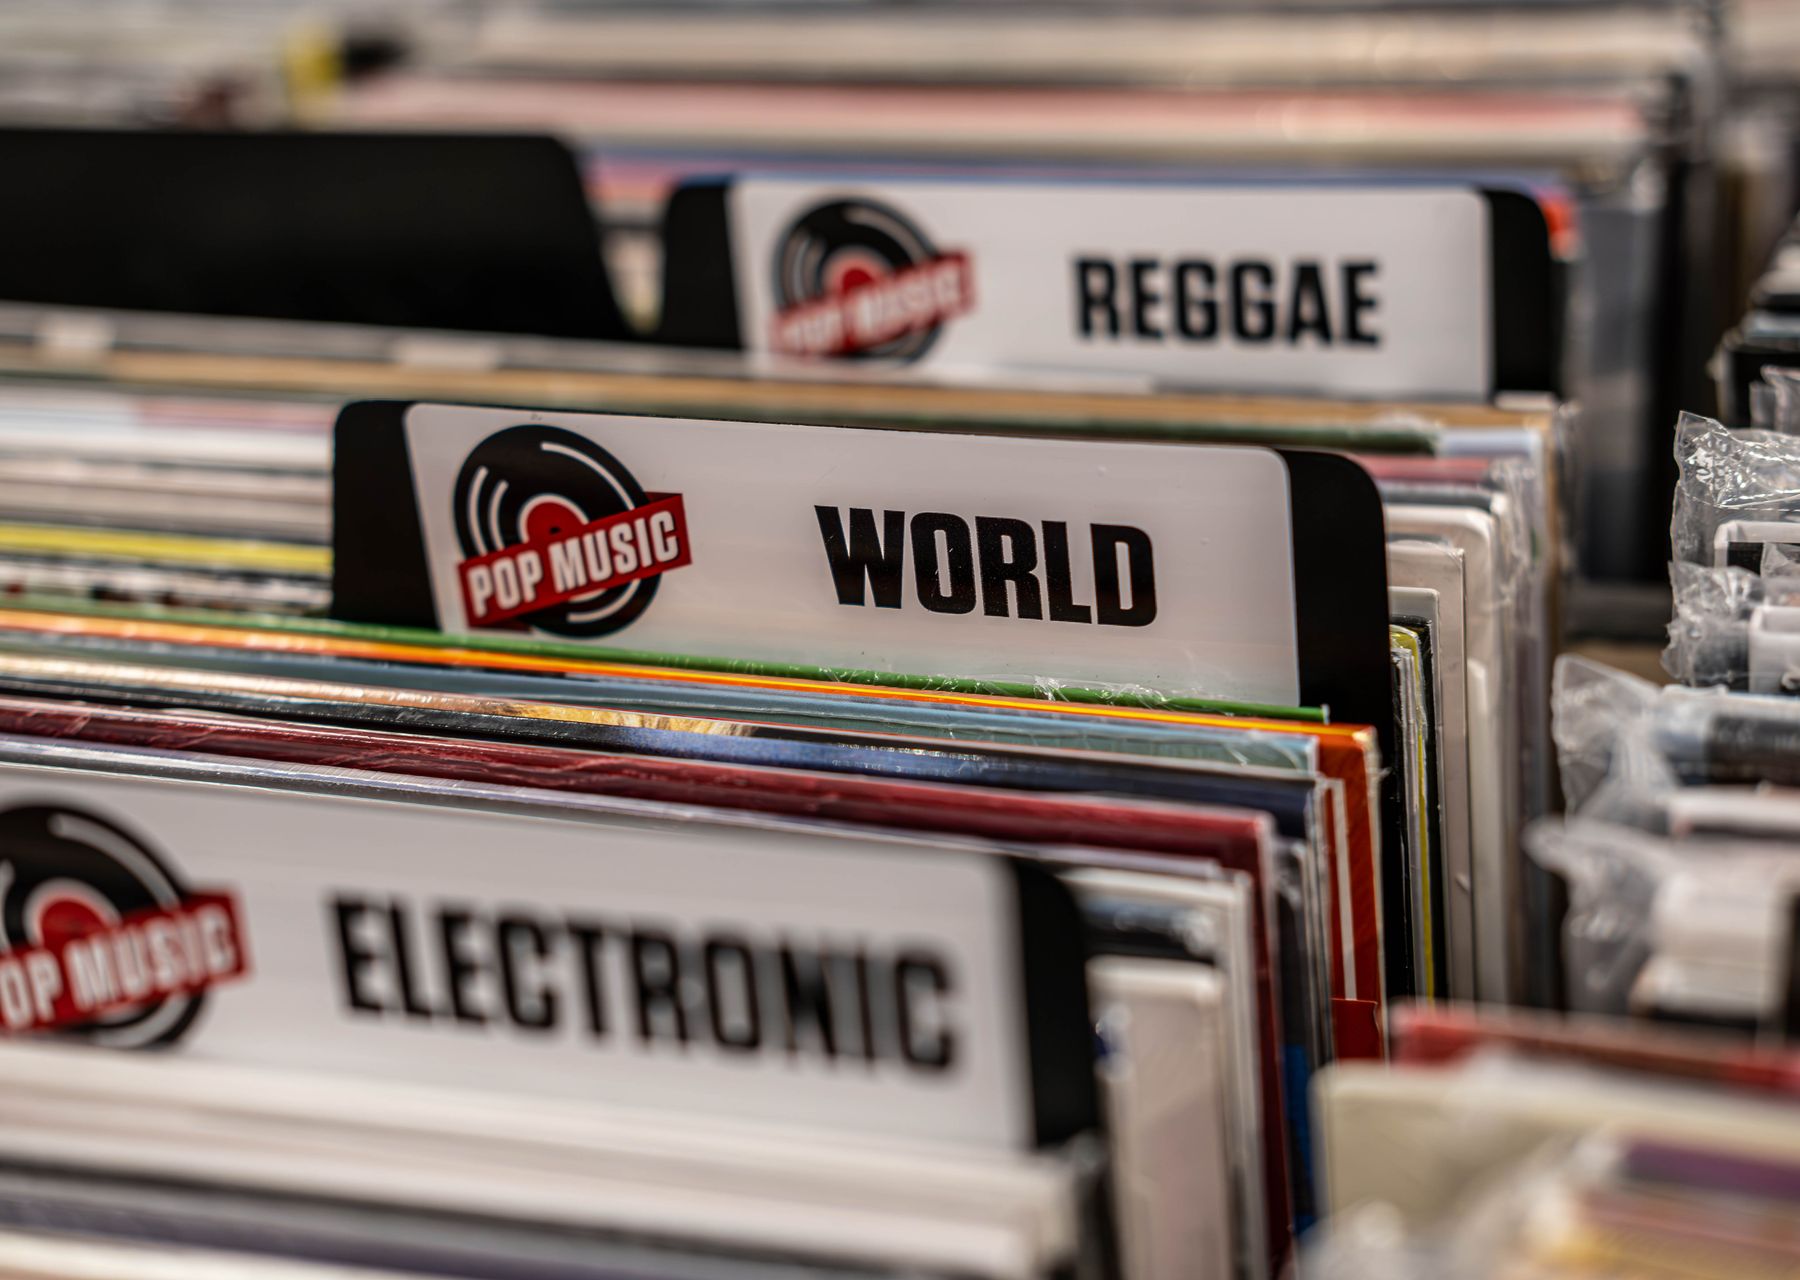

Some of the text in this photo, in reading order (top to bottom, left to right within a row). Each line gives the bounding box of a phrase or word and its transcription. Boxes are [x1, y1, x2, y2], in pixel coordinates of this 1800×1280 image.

[1071, 254, 1382, 347] REGGAE
[467, 511, 679, 618] POP MUSIC
[814, 504, 1157, 627] WORLD
[0, 903, 236, 1030] OP MUSIC
[329, 893, 959, 1075] ELECTRONIC
